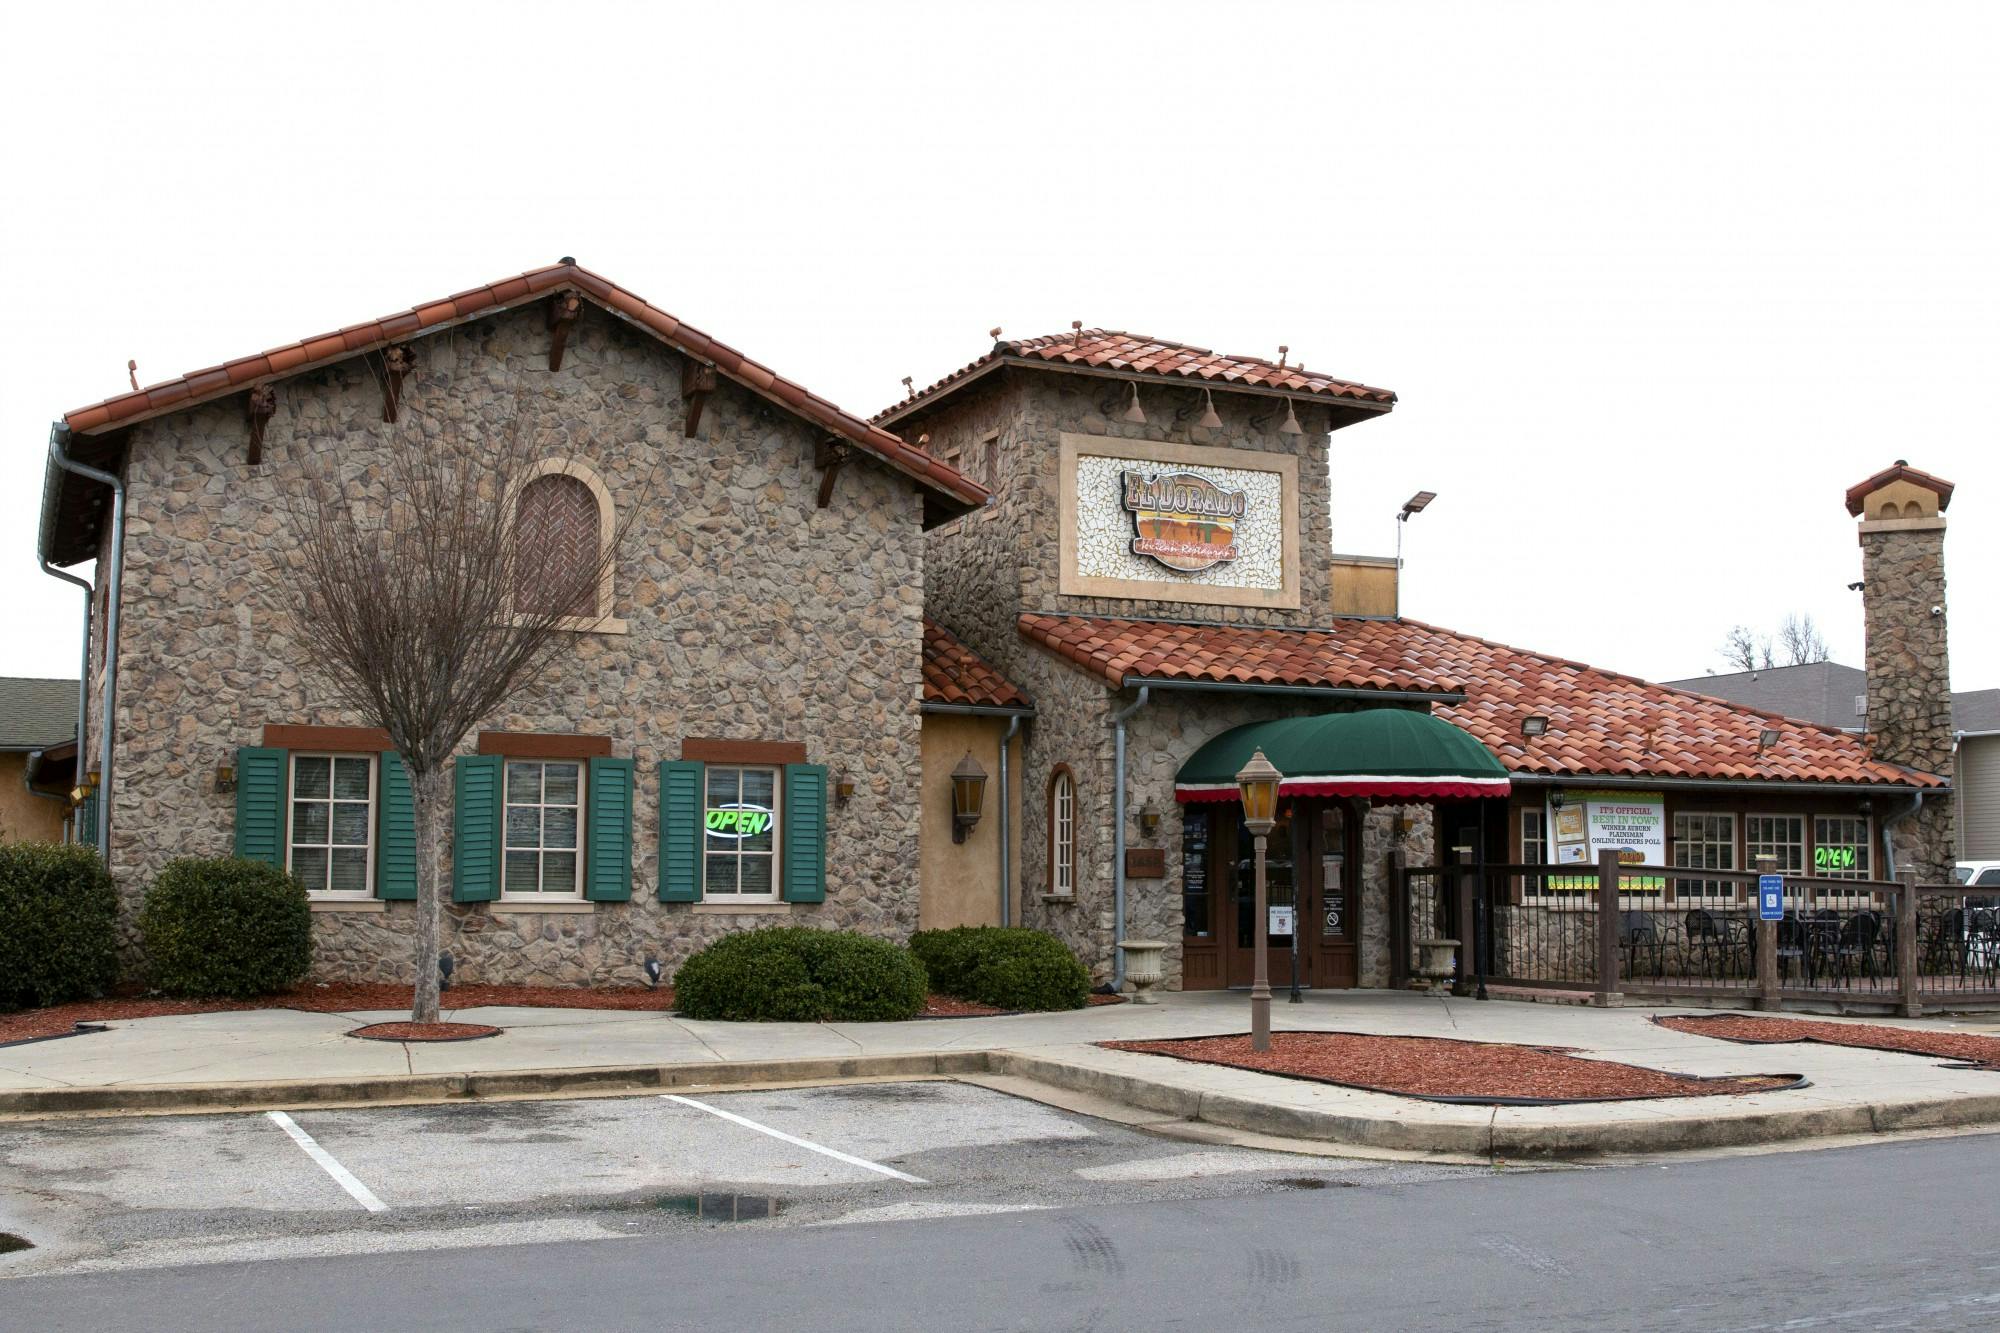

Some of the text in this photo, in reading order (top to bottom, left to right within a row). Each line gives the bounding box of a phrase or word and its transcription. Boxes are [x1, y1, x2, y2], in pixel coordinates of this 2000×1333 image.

[1159, 479, 1246, 517] DORADO
[706, 811, 767, 834] OPEN
[1592, 815, 1660, 825] BEST IN TOWN
[1815, 847, 1852, 867] OPEN
